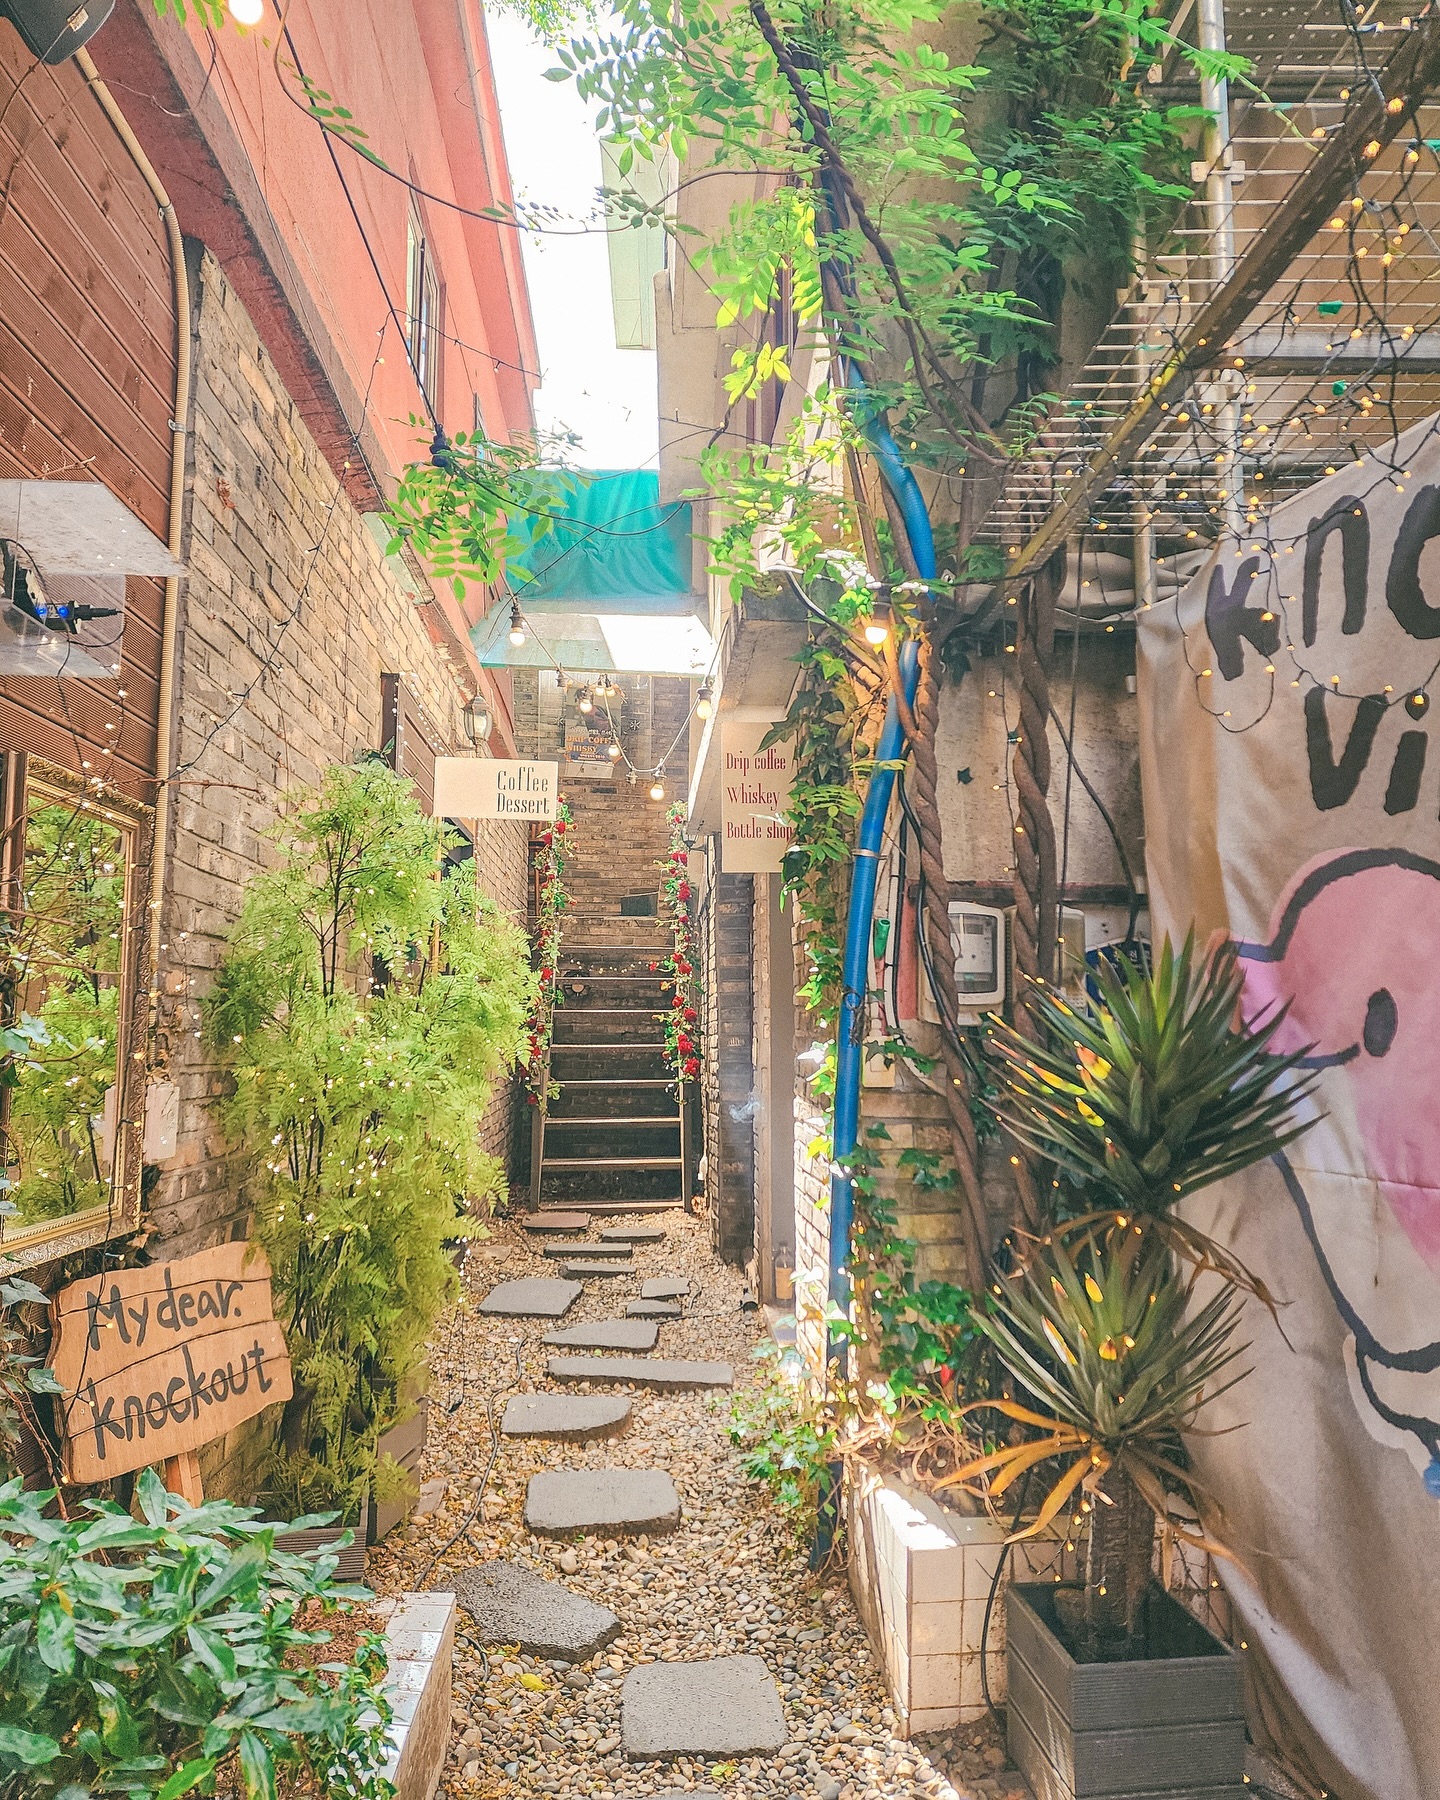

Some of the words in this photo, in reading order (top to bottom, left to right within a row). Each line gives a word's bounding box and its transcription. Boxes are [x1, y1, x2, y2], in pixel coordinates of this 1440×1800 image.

[725, 750, 750, 777] Drip
[754, 748, 786, 770] coffee
[497, 766, 549, 793] Coffee
[497, 792, 550, 815] Dessert
[726, 782, 781, 812] Whiskey
[726, 817, 762, 839] Bottle
[766, 820, 792, 842] shop
